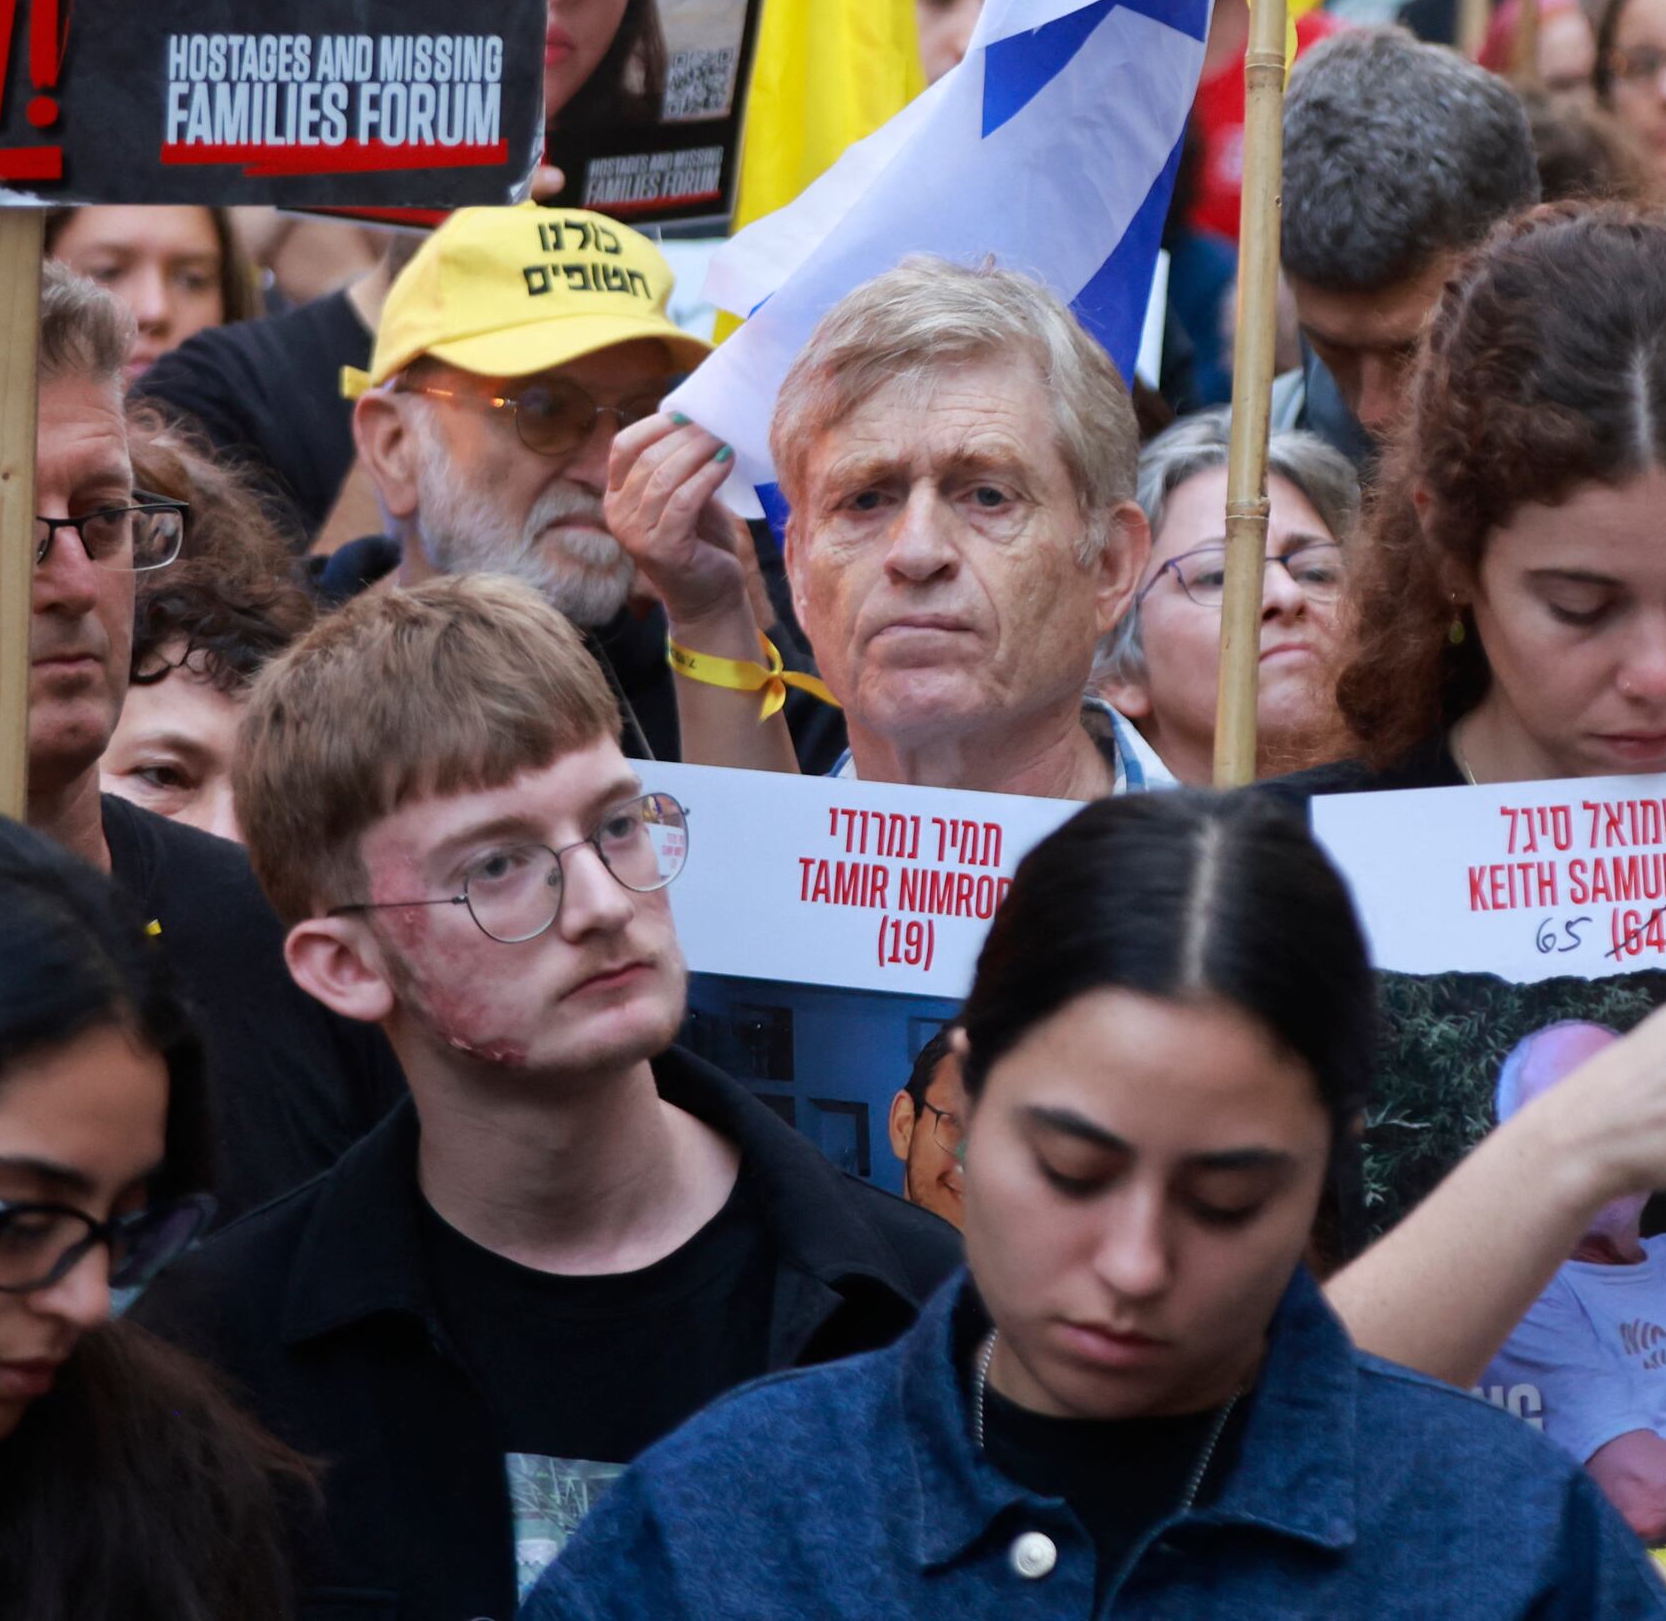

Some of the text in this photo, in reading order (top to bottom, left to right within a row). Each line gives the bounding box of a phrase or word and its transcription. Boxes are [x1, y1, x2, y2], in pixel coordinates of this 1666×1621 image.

[169, 34, 503, 83] HOSTAGES AND MISSING
[167, 81, 502, 146] FAMILIES FORUM
[585, 166, 720, 205] FAMILIES FORUM
[538, 218, 622, 255] כולנו
[523, 262, 653, 300] חטופים
[829, 807, 1003, 868] תמיר נמרודי
[1500, 804, 1573, 855] סיגל
[798, 857, 889, 909] TAMIR
[1467, 860, 1559, 912] KEITH
[878, 915, 935, 972] (19)
[1535, 916, 1592, 954] 65
